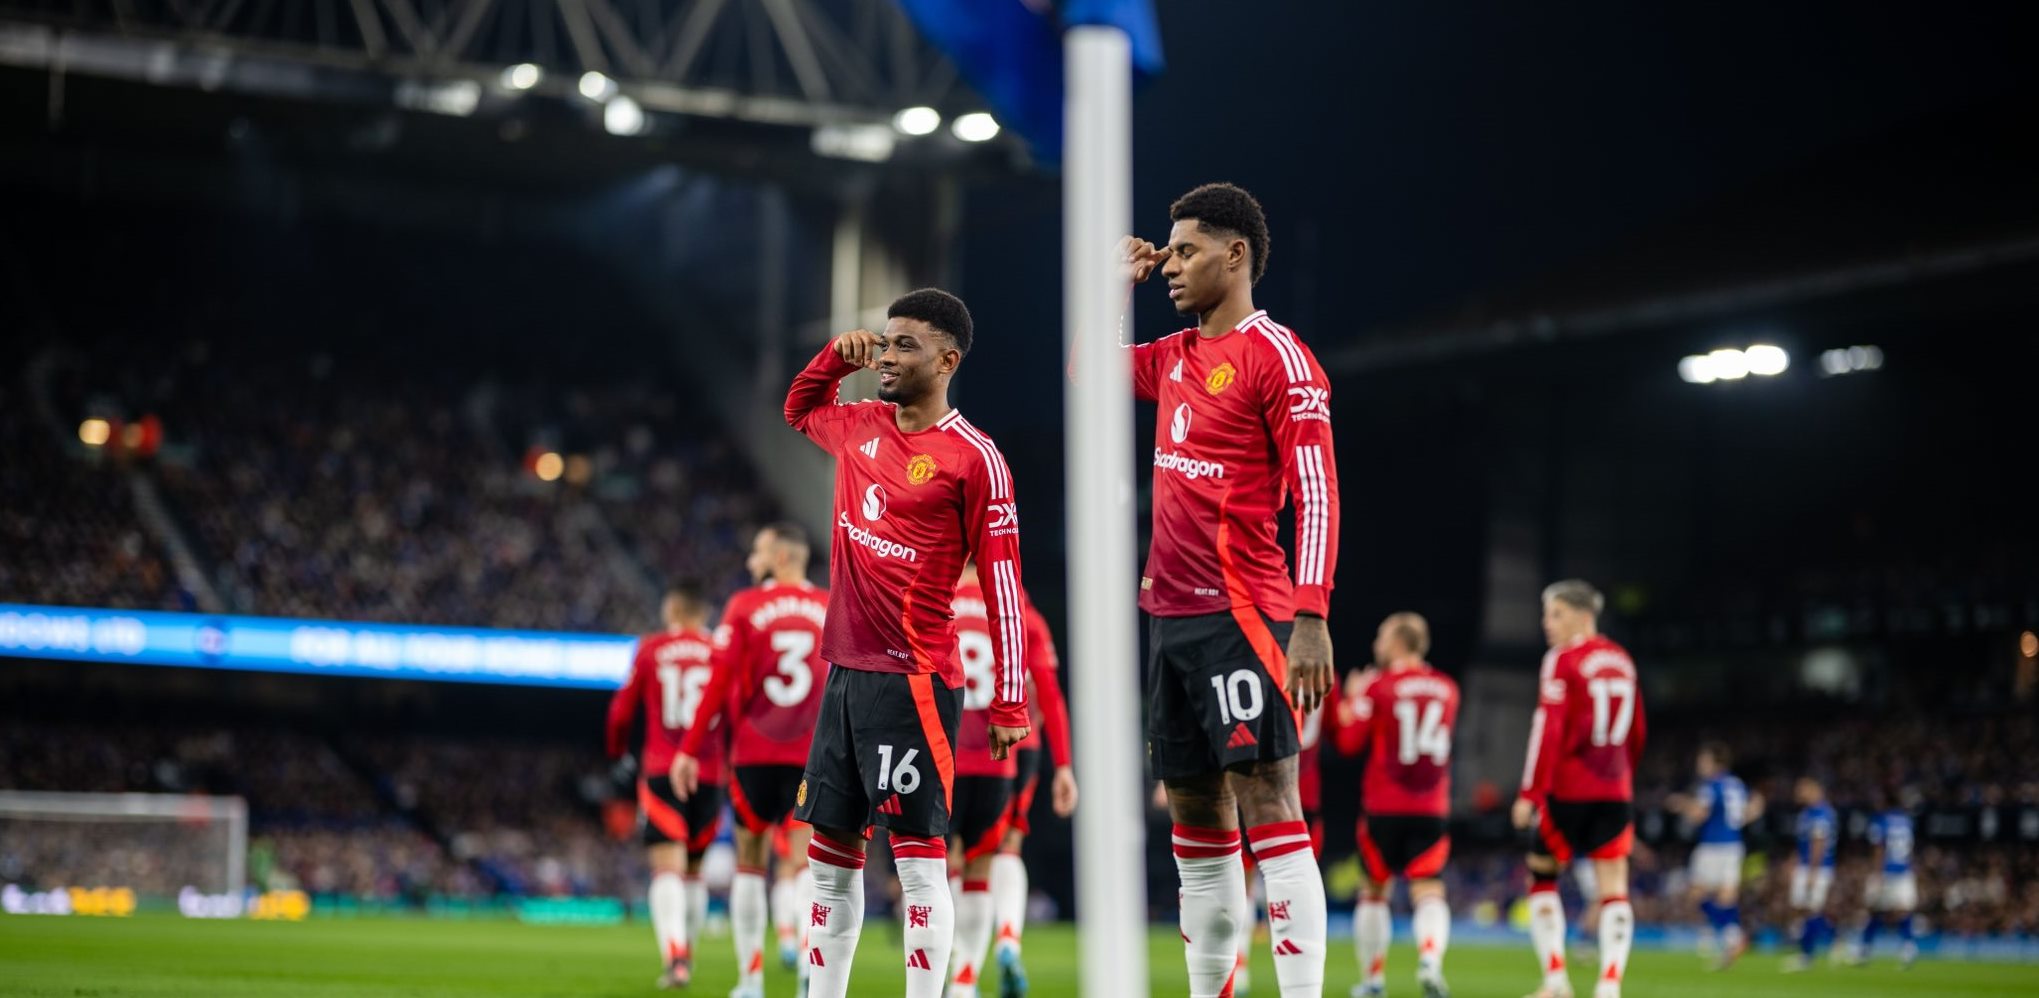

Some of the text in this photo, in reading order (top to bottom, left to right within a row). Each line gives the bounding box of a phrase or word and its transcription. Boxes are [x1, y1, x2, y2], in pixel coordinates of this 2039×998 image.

[763, 630, 814, 707] 3
[1210, 669, 1264, 725] 10
[1393, 699, 1451, 767] 14
[1587, 678, 1635, 747] 17
[877, 744, 921, 795] 16
